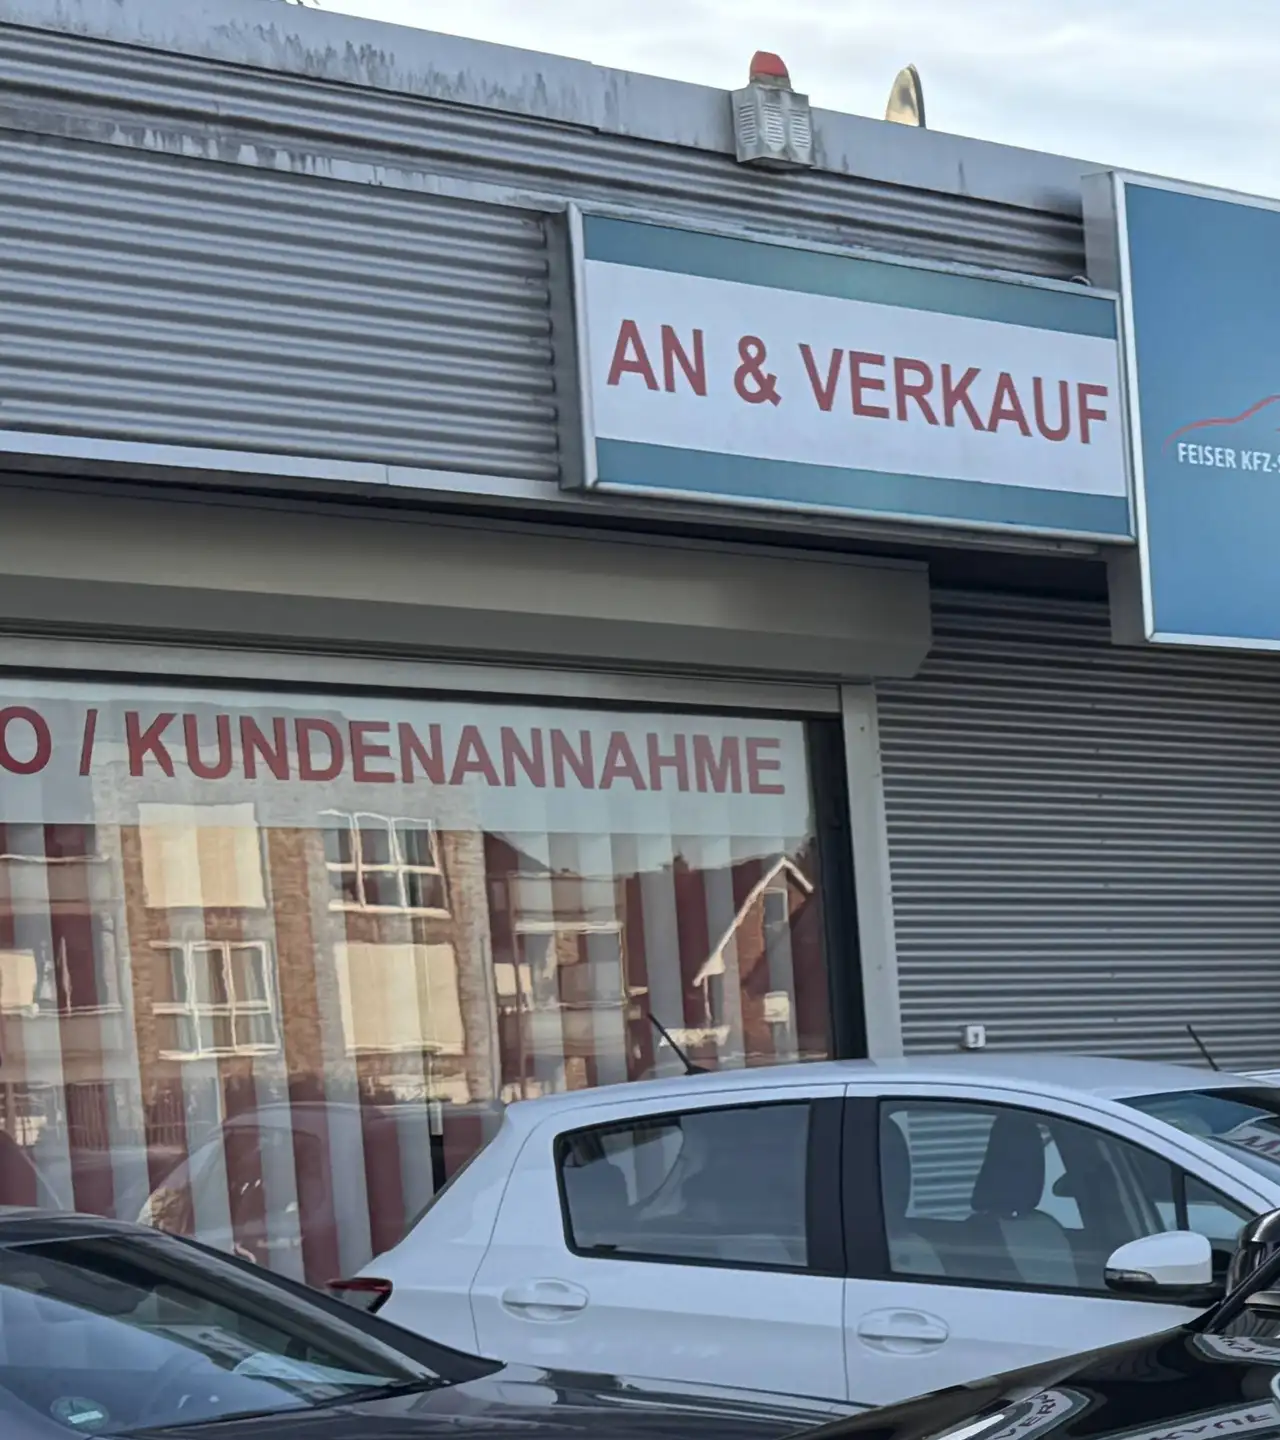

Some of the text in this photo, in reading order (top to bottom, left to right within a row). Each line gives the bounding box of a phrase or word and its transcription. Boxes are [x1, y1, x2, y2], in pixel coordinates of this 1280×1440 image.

[606, 318, 1109, 444] AN & VERKAUF
[1177, 442, 1237, 469] FEISER
[78, 708, 98, 777] /
[124, 710, 787, 796] KUNDENANNAHME
